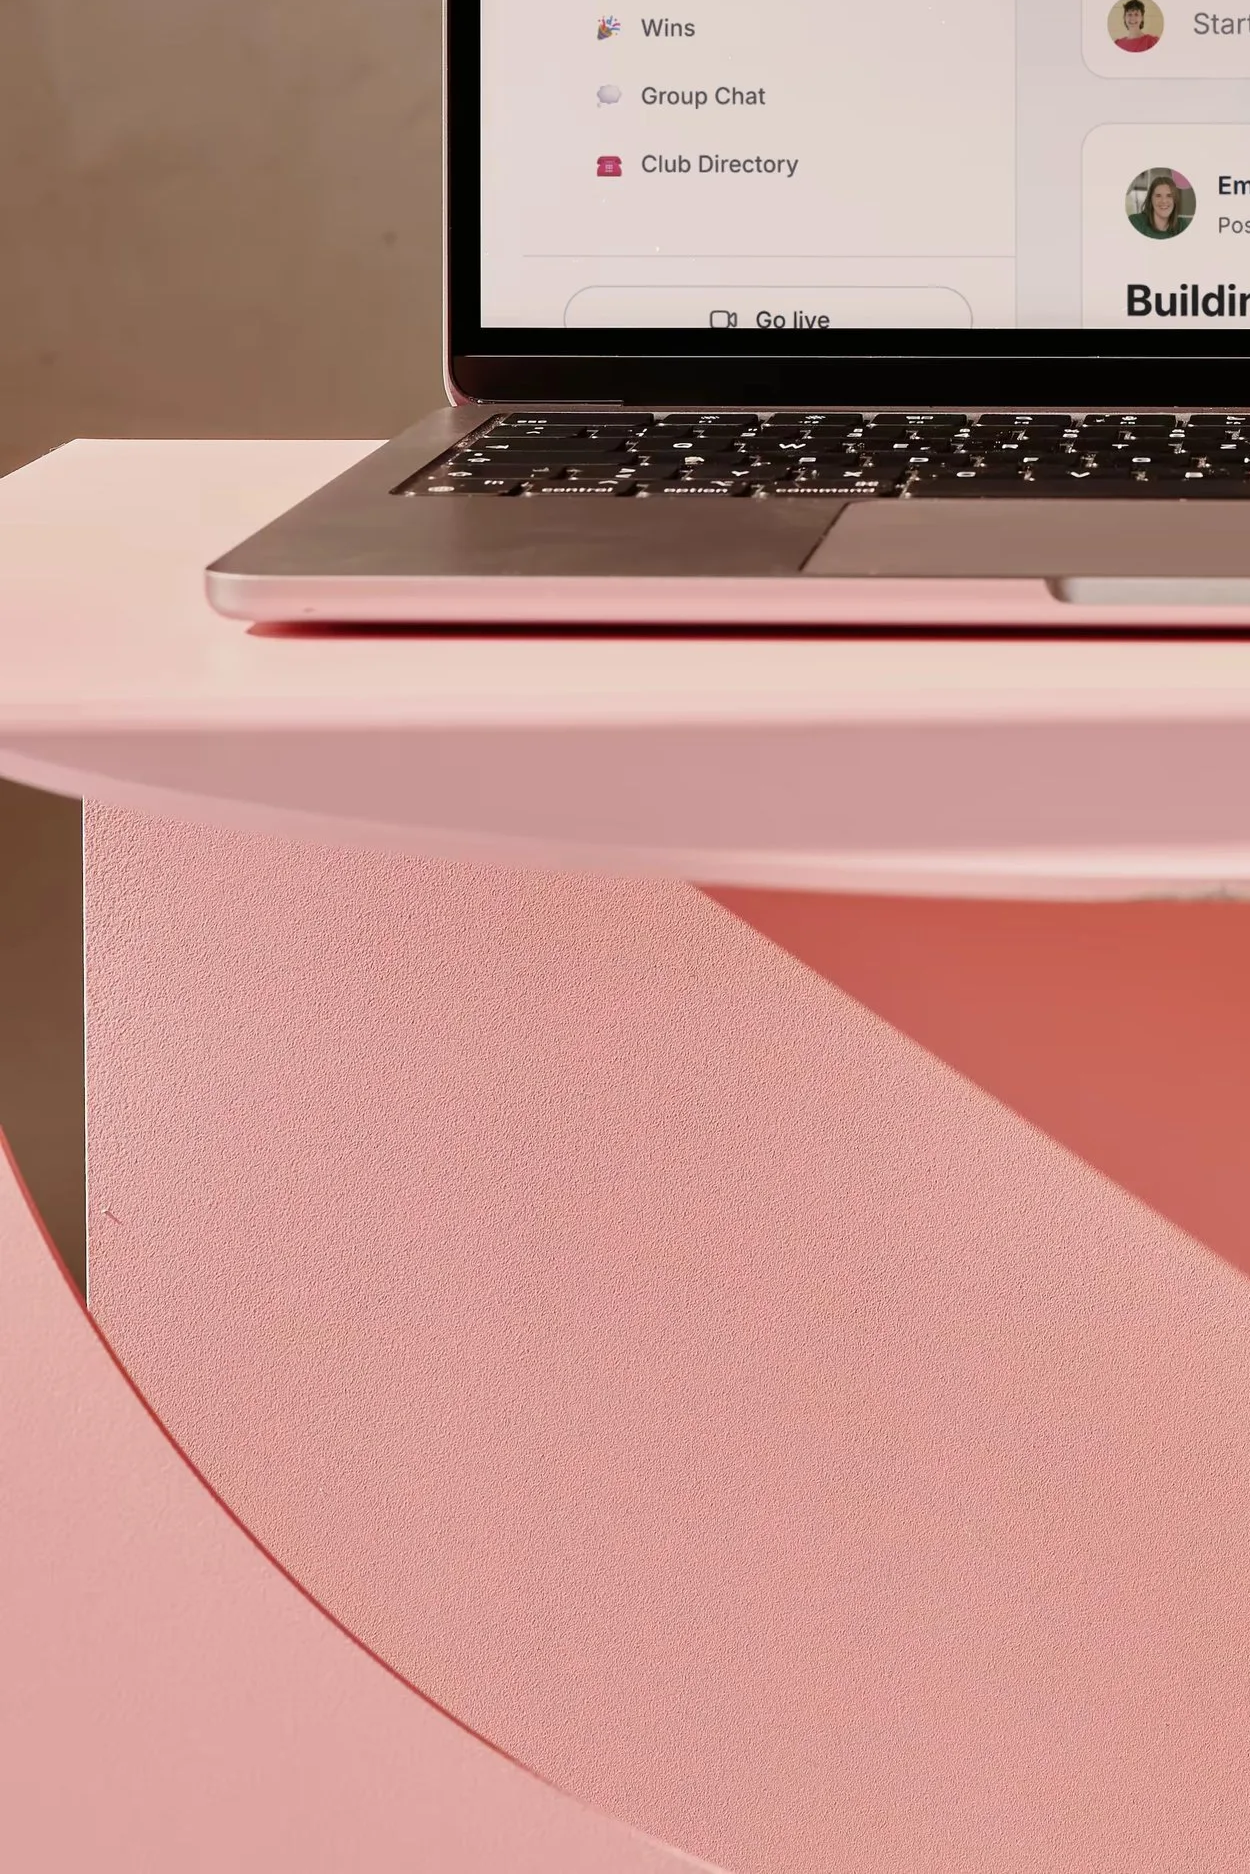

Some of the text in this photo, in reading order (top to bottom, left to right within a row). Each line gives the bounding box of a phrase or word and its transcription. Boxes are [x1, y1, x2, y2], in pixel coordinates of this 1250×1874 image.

[640, 17, 696, 38] Wins
[641, 86, 766, 110] Group Chat
[641, 154, 799, 179] Club Directory
[756, 310, 831, 328] Go live
